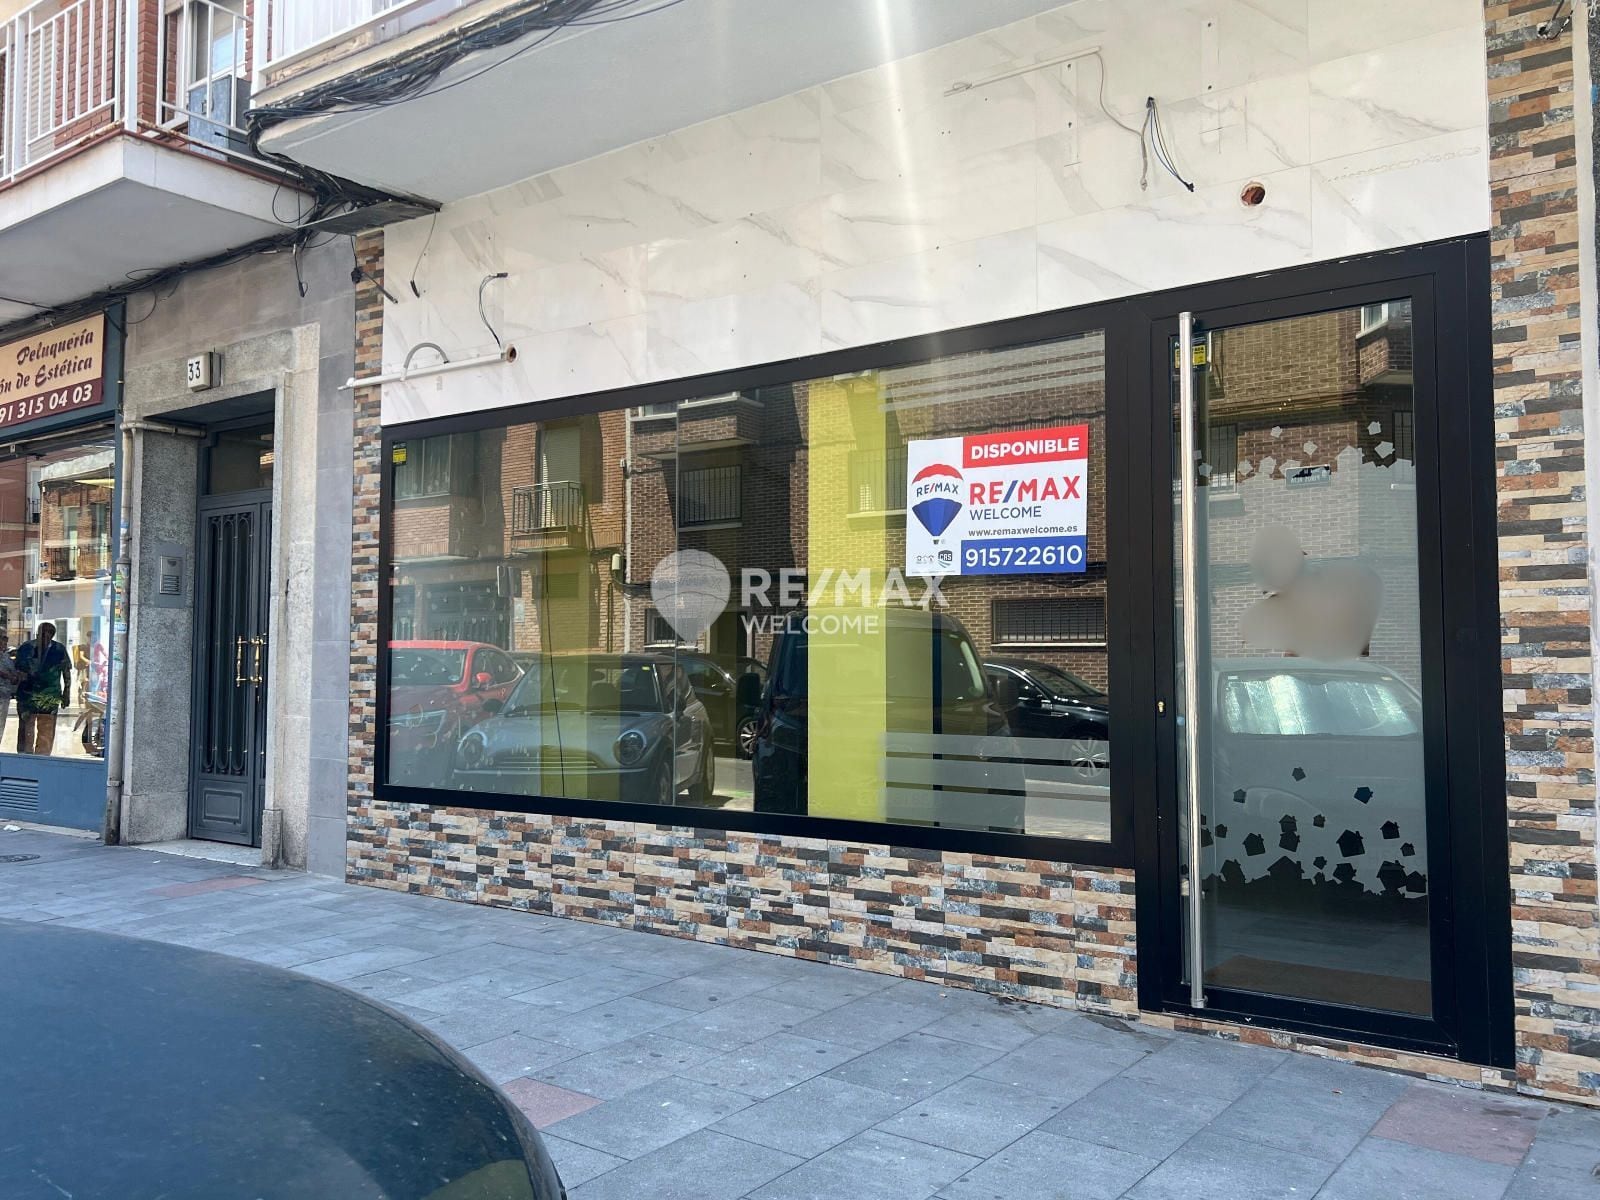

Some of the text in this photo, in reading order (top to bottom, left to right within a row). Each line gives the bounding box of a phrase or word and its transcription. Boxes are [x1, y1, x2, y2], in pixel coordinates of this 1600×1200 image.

[17, 328, 94, 366] Peluquería
[16, 372, 30, 389] de
[35, 356, 93, 388] Estética
[188, 361, 201, 382] 33
[0, 383, 93, 423] 91 315 04 03
[971, 437, 1080, 460] DISPONIBLE
[916, 481, 959, 498] RE/MAX
[969, 475, 1081, 506] RE/MAX
[969, 505, 1042, 521] WELCOME
[968, 524, 1078, 537] www.remaxwelcome.es
[965, 545, 1083, 567] 915722610
